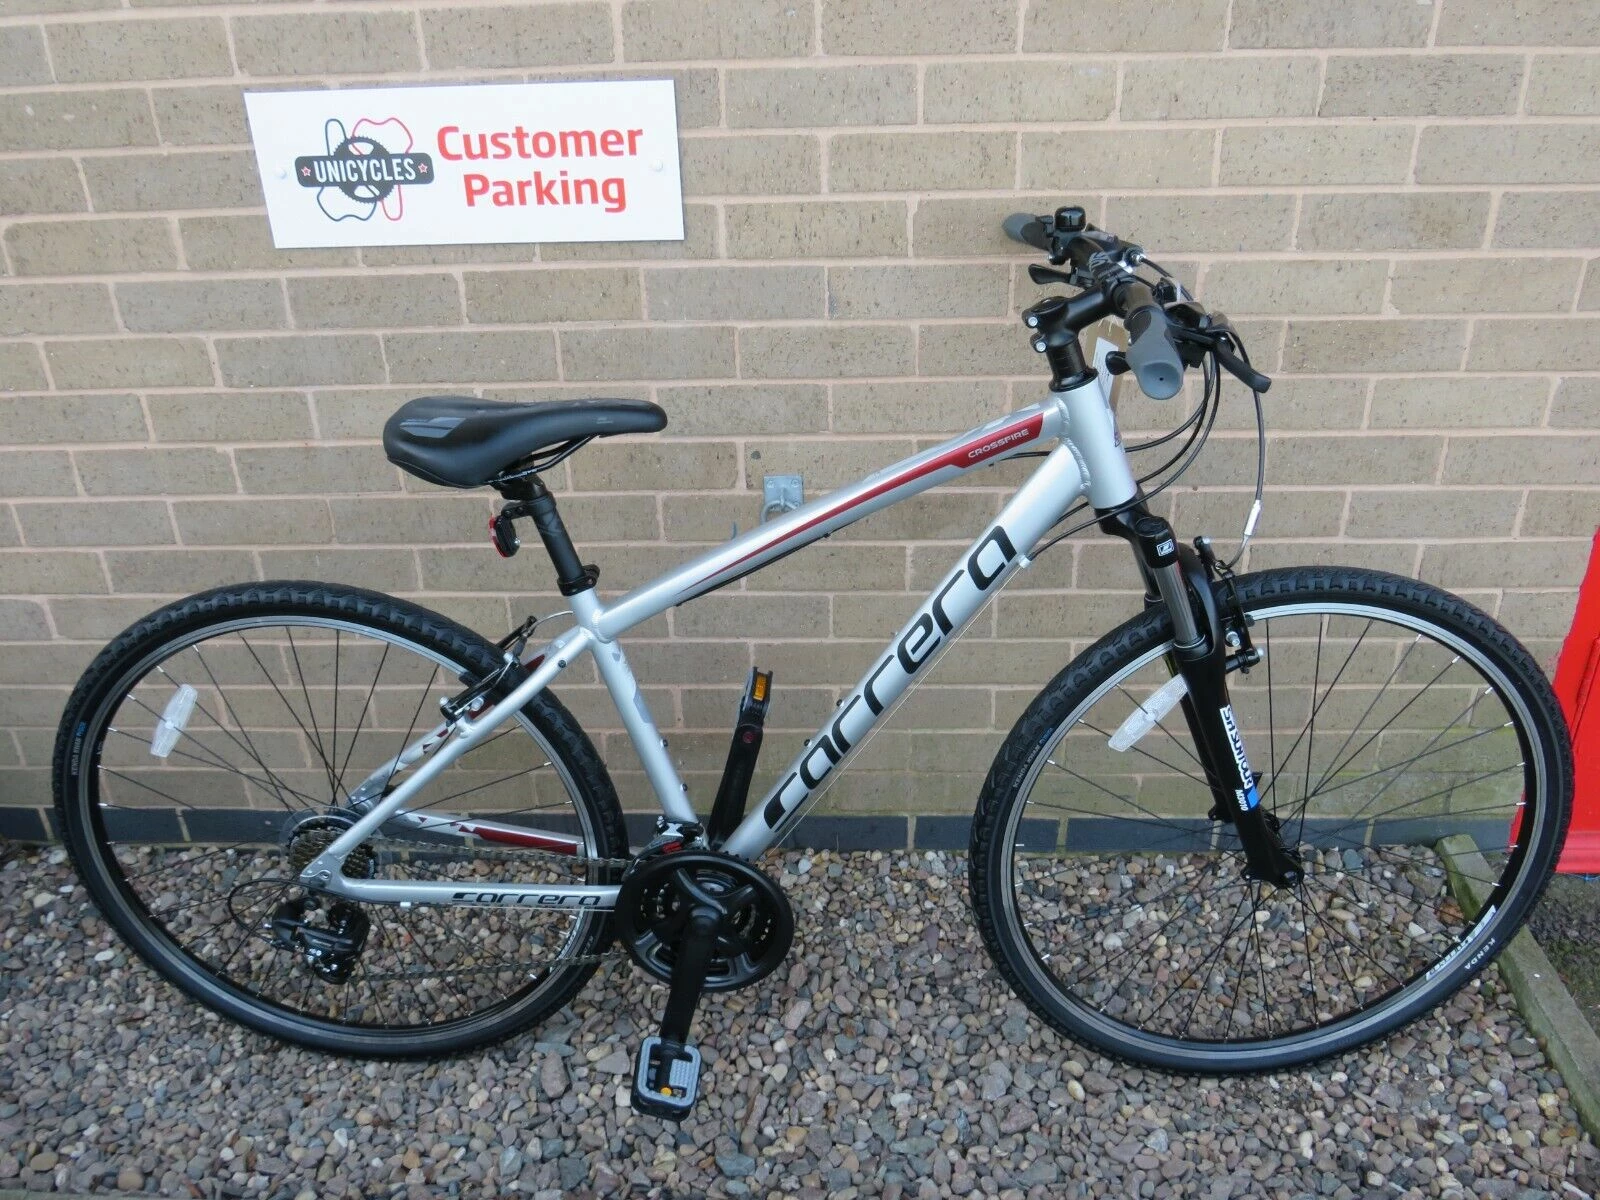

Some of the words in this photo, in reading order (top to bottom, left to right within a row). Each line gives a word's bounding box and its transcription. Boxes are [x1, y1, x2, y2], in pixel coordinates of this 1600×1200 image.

[436, 125, 643, 160] Customer
[313, 158, 416, 183] UNICYCLES
[463, 171, 627, 213] Parking
[968, 428, 1030, 458] CROSSFIRE
[763, 525, 1017, 832] carrera
[452, 892, 602, 906] carrera
[1464, 937, 1496, 970] KENDA
